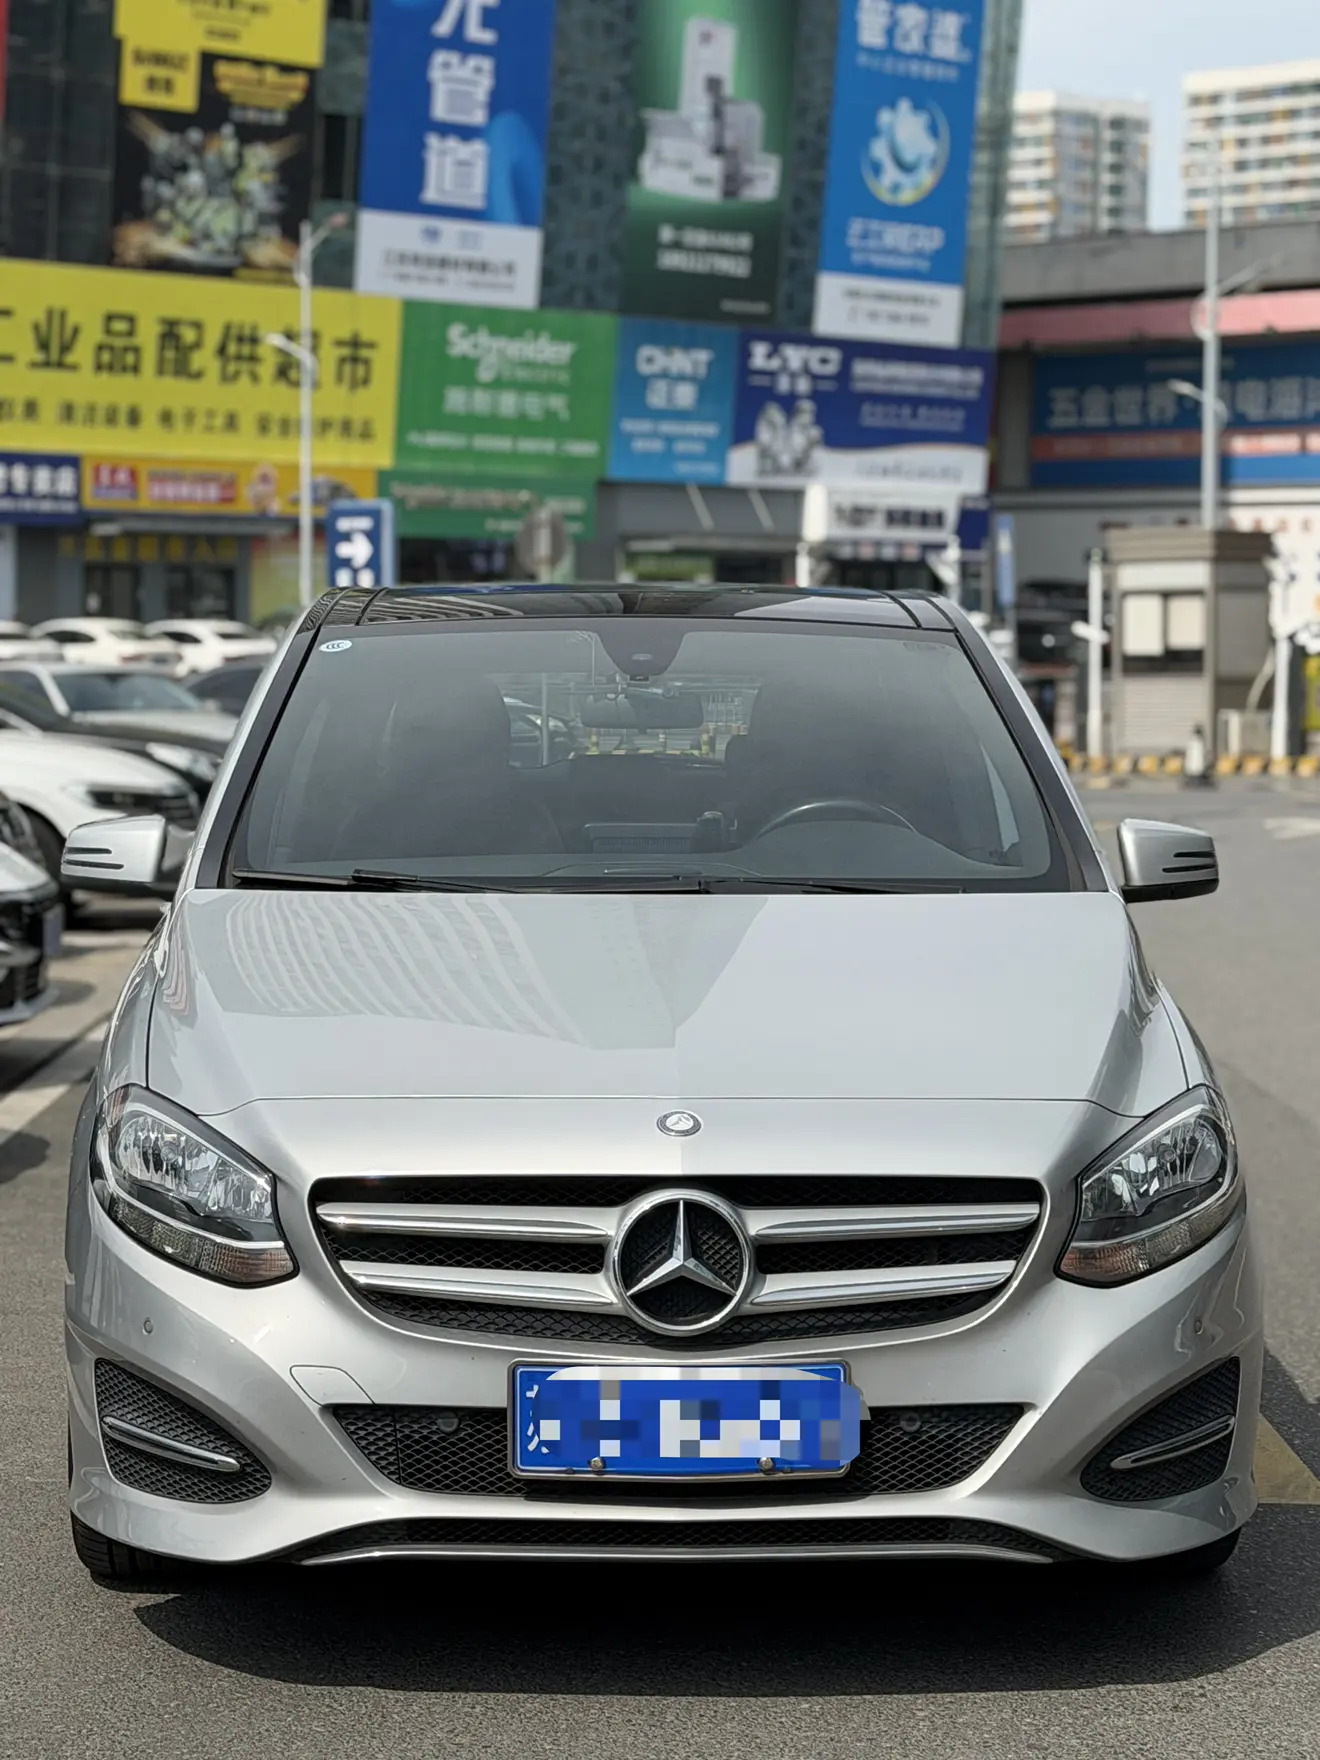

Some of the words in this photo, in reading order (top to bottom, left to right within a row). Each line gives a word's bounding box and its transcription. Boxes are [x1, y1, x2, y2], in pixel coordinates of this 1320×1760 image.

[0, 305, 379, 393] 业品配供超市
[447, 320, 577, 366] Schneider
[748, 341, 842, 376] LYC
